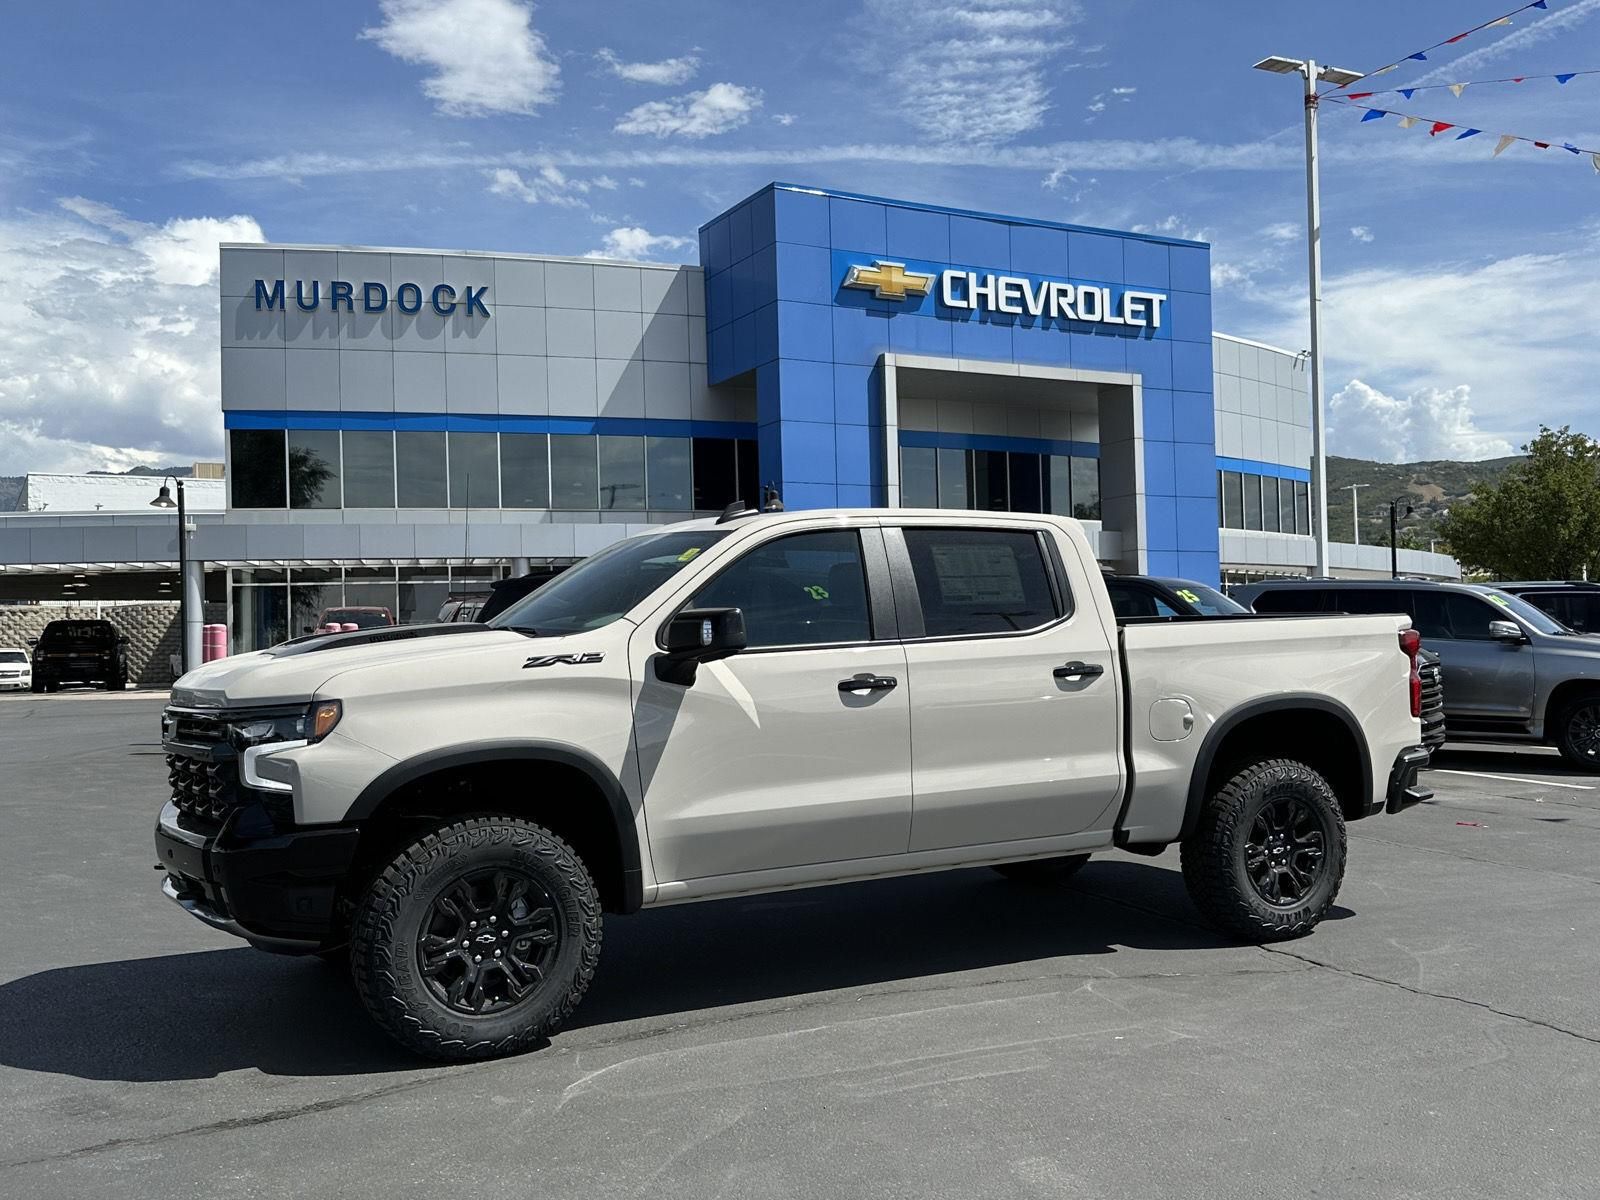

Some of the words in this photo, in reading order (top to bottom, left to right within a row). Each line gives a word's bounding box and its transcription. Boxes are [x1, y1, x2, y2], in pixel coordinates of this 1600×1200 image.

[254, 279, 491, 318] MURDOCK
[942, 269, 1167, 328] CHEVROLET
[522, 652, 606, 669] ZR2
[392, 938, 474, 1039] GOODYEAR
